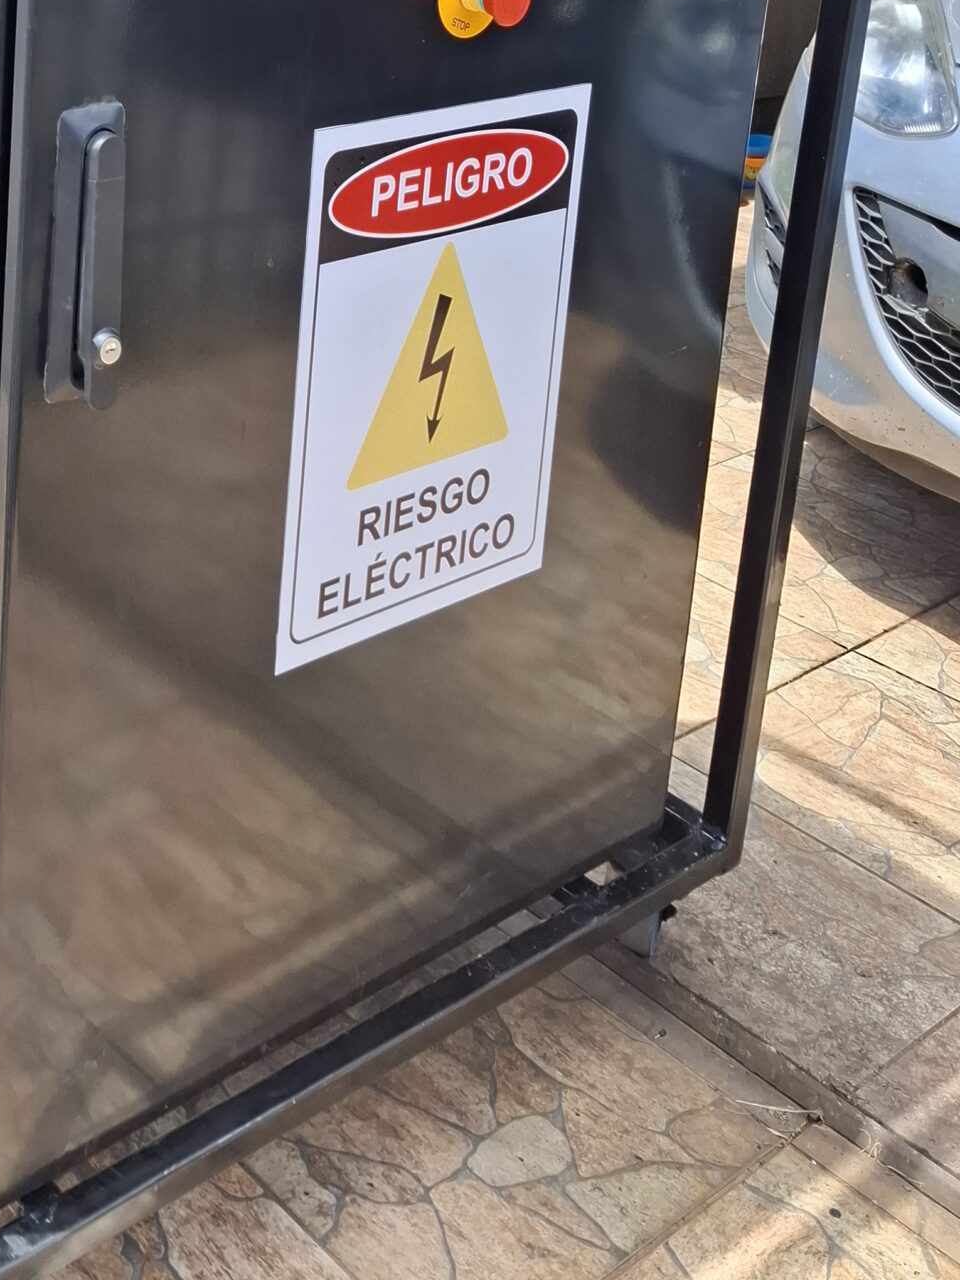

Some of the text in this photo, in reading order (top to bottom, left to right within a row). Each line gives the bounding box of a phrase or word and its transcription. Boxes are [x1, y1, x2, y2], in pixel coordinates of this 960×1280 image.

[451, 17, 471, 32] STOP
[370, 147, 533, 218] PELIGRO
[356, 467, 491, 547] RIESGO
[317, 512, 515, 619] ELÉCTRICO
